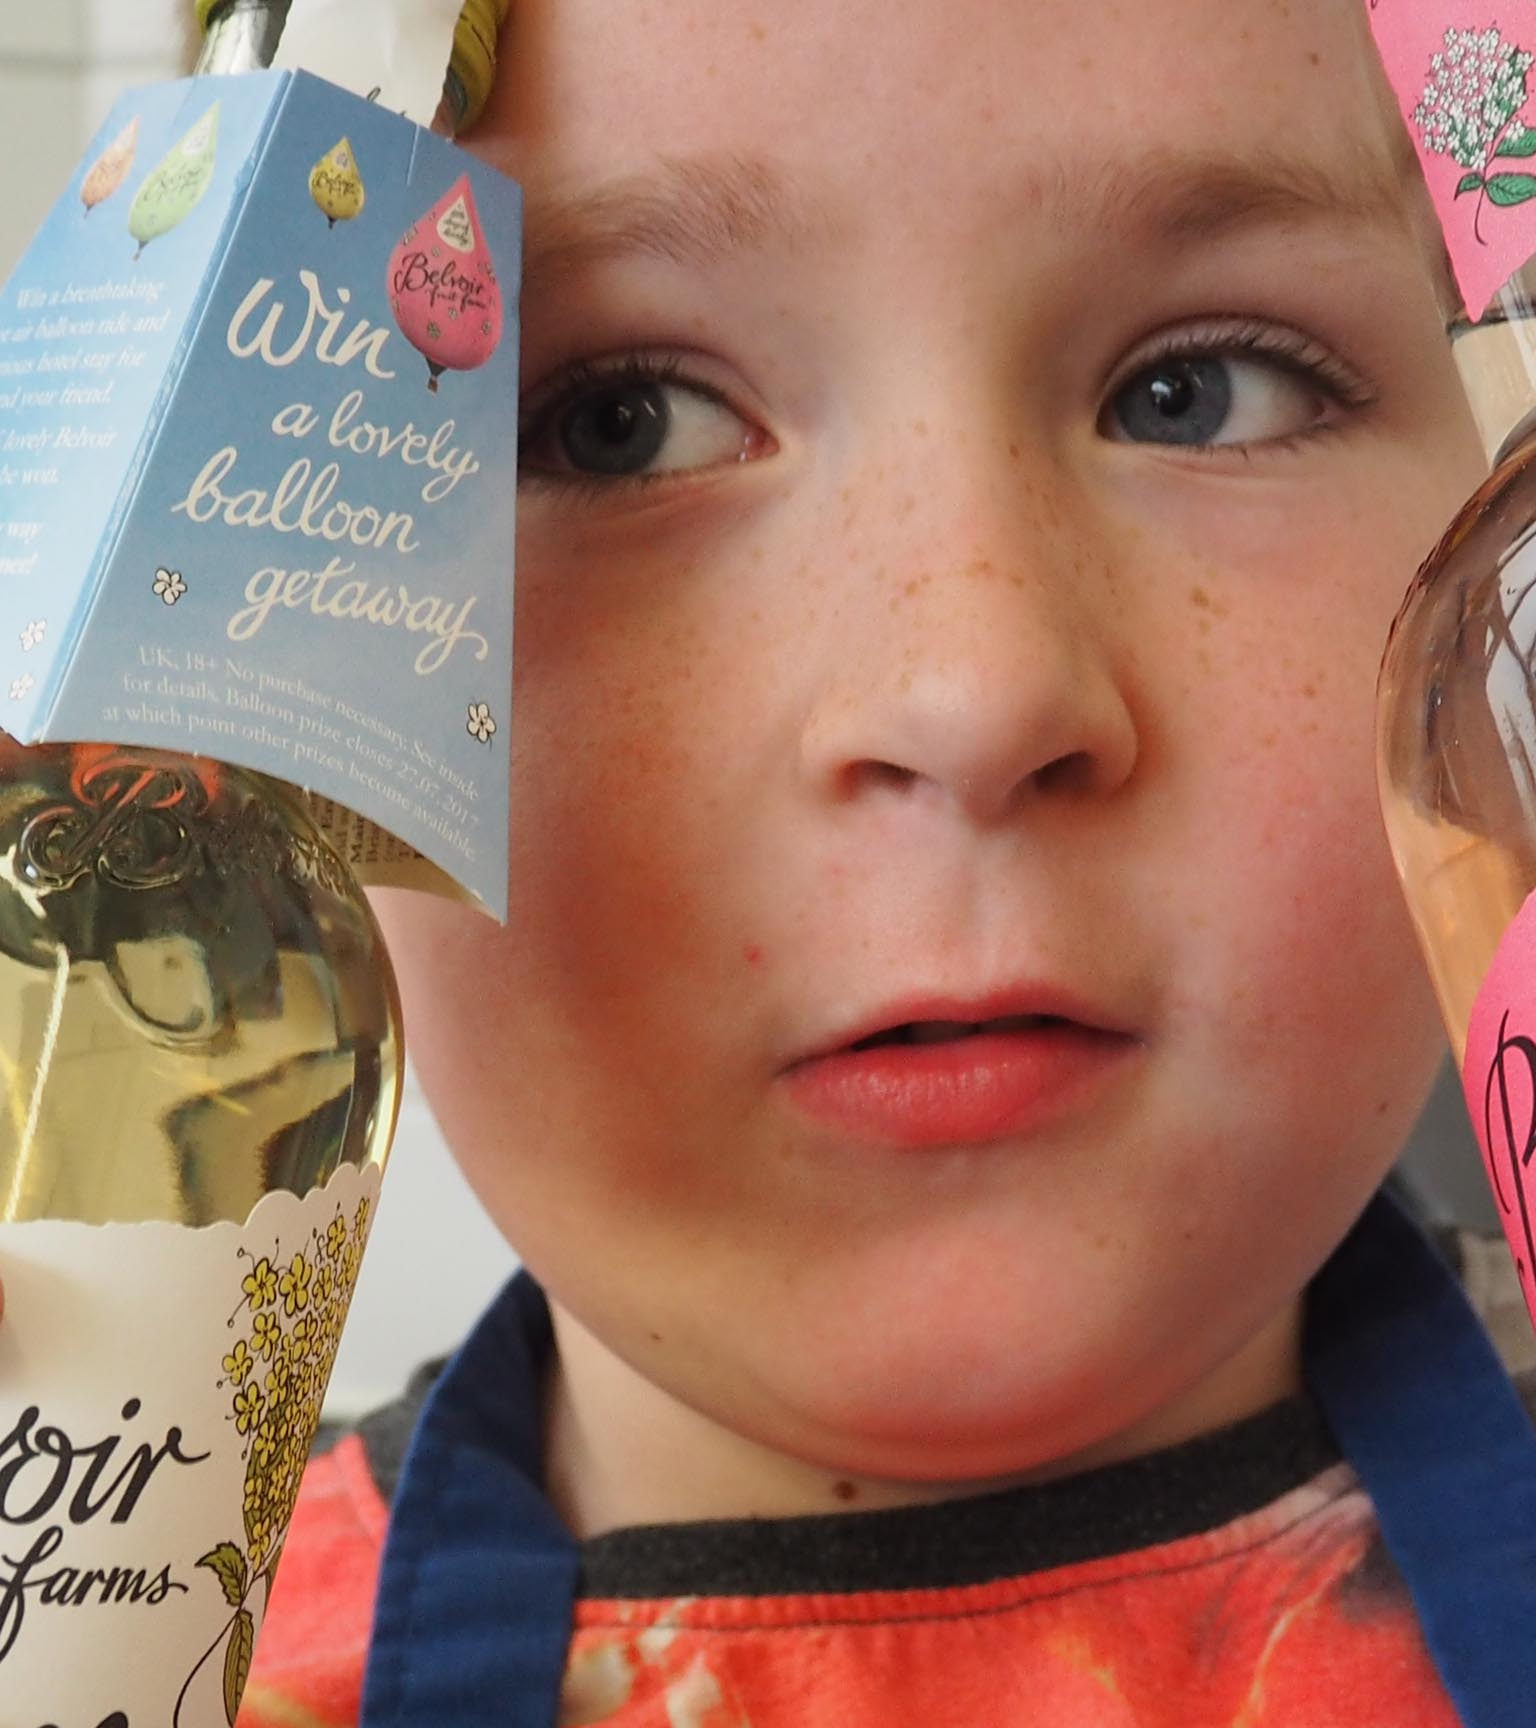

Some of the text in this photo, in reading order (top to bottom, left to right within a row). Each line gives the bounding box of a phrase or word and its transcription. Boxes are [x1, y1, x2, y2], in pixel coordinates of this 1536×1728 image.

[227, 269, 395, 379] Win
[394, 252, 486, 294] Belvoir
[170, 445, 420, 552] balloon
[271, 390, 480, 502] a lovely
[226, 555, 489, 675] getaway
[121, 671, 153, 693] for
[226, 687, 295, 724] Balloon
[298, 710, 343, 744] prize
[345, 734, 394, 771] closes
[224, 658, 255, 682] No
[258, 672, 333, 709] purchase
[101, 705, 121, 722] at
[123, 701, 183, 726] which
[187, 711, 237, 735] point
[240, 723, 292, 750] other
[293, 739, 345, 774] prizes
[348, 760, 411, 811] become
[412, 803, 480, 864] available
